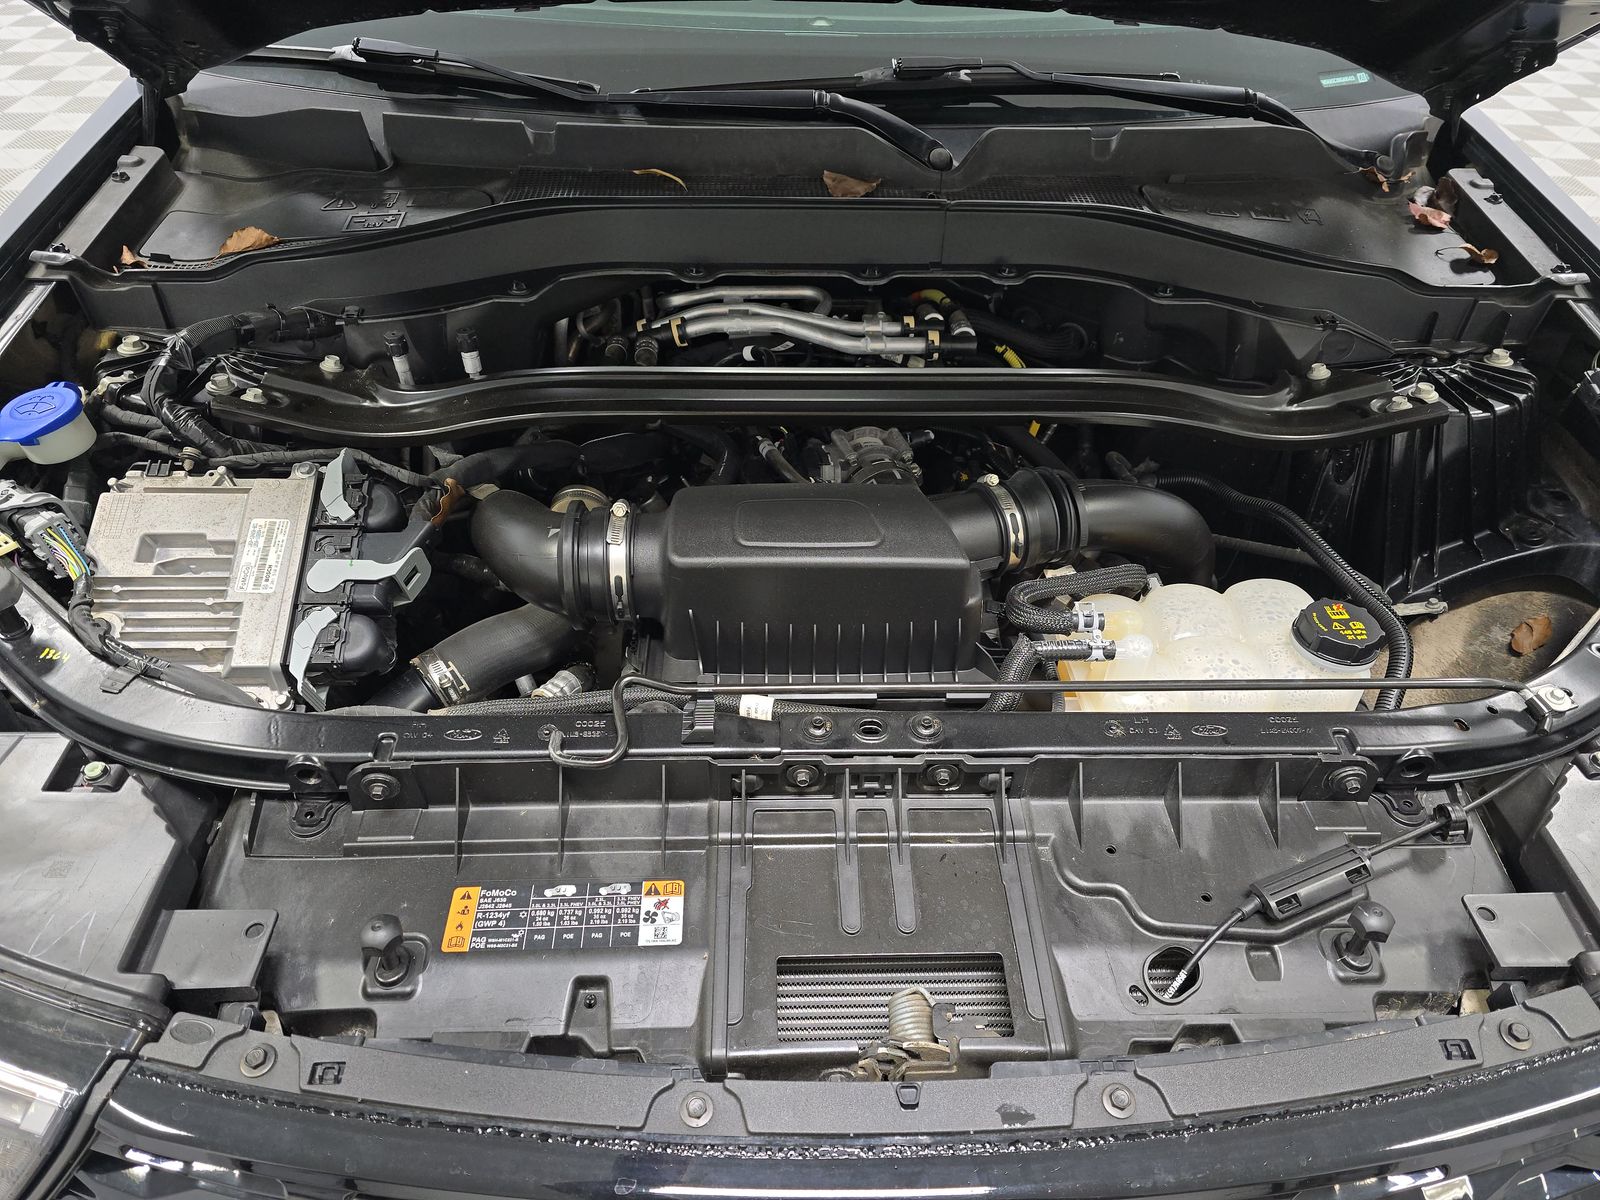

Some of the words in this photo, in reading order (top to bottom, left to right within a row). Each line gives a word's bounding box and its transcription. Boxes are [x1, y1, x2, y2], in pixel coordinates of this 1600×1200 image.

[264, 564, 273, 582] BOSCH
[239, 566, 251, 590] FoMoCo
[480, 889, 517, 897] FoMoCo
[476, 911, 511, 919] R-1234yf
[547, 909, 555, 917] kg
[474, 920, 497, 928] (GWP
[498, 920, 506, 928] 4)
